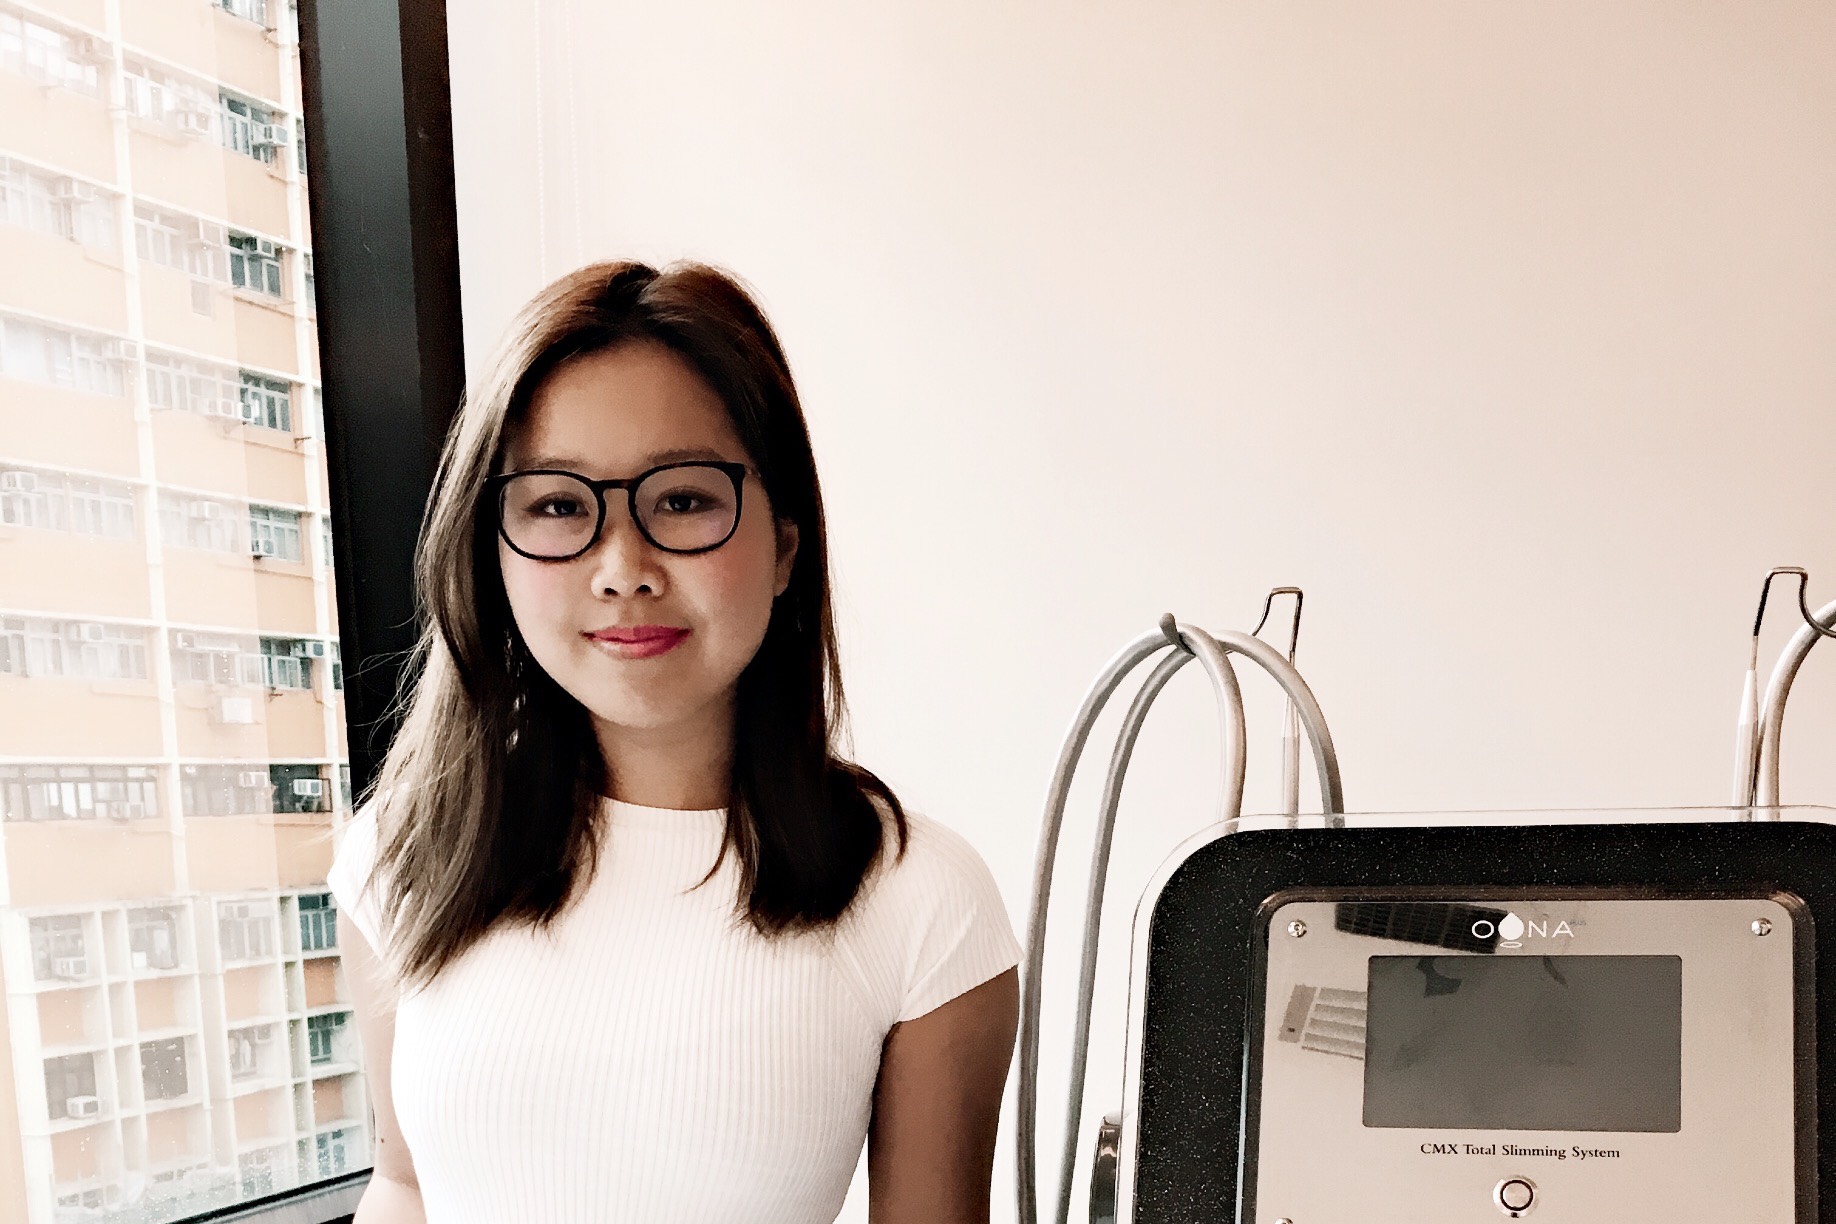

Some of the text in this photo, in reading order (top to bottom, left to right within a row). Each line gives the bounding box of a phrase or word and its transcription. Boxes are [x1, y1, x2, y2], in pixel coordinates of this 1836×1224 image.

[1420, 1143, 1620, 1160] CMX Total Slimming System
